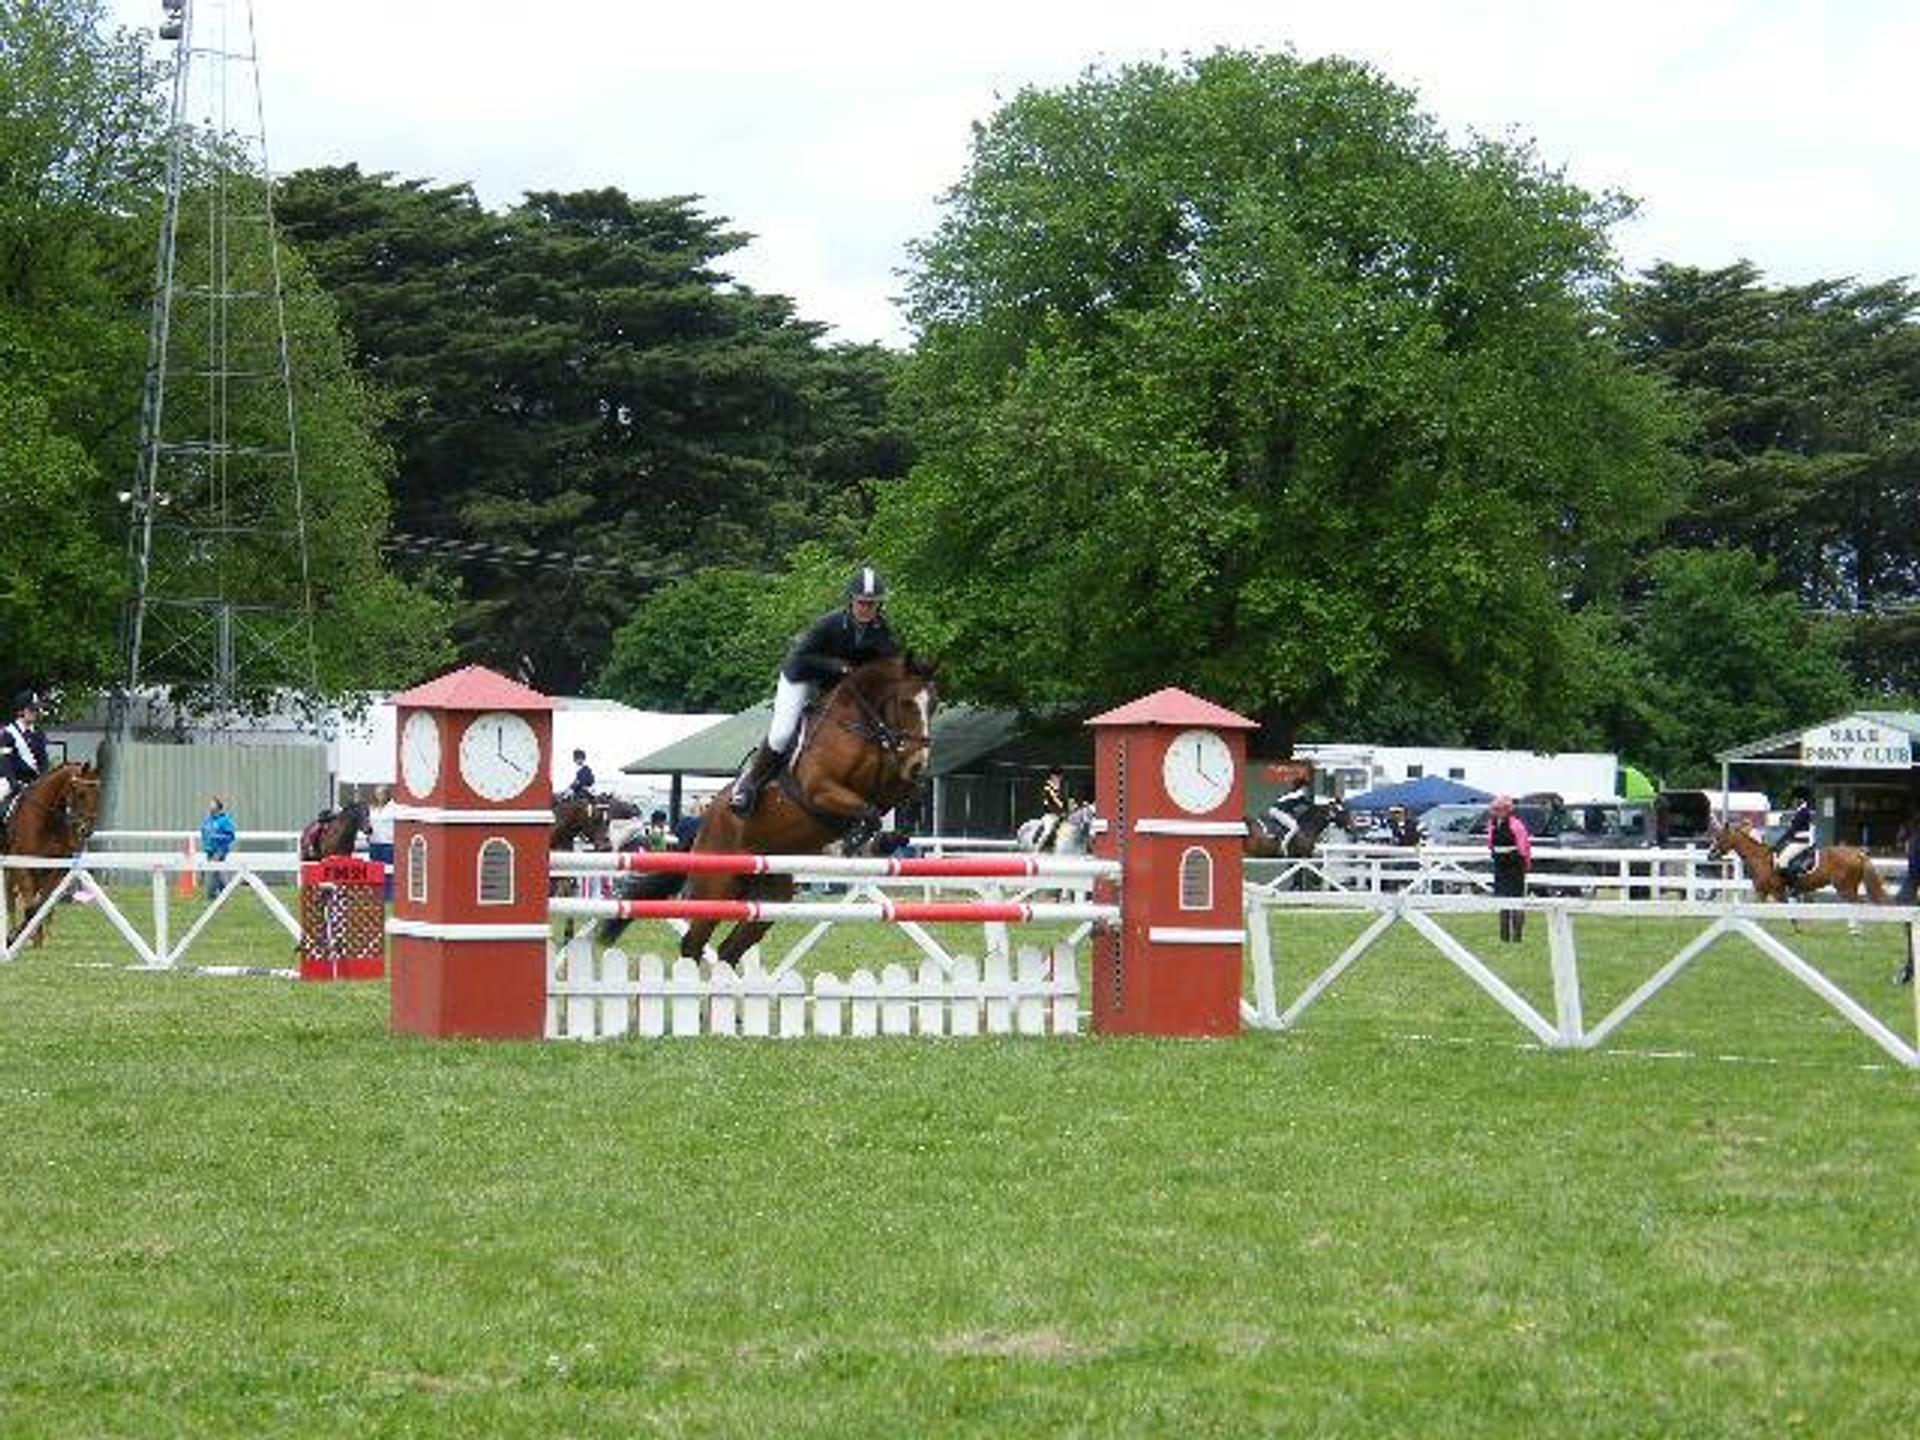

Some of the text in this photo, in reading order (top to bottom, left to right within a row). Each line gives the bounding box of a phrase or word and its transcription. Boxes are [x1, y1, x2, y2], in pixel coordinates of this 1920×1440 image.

[1829, 729, 1879, 742] SALE
[1805, 747, 1909, 763] PONY CLUB
